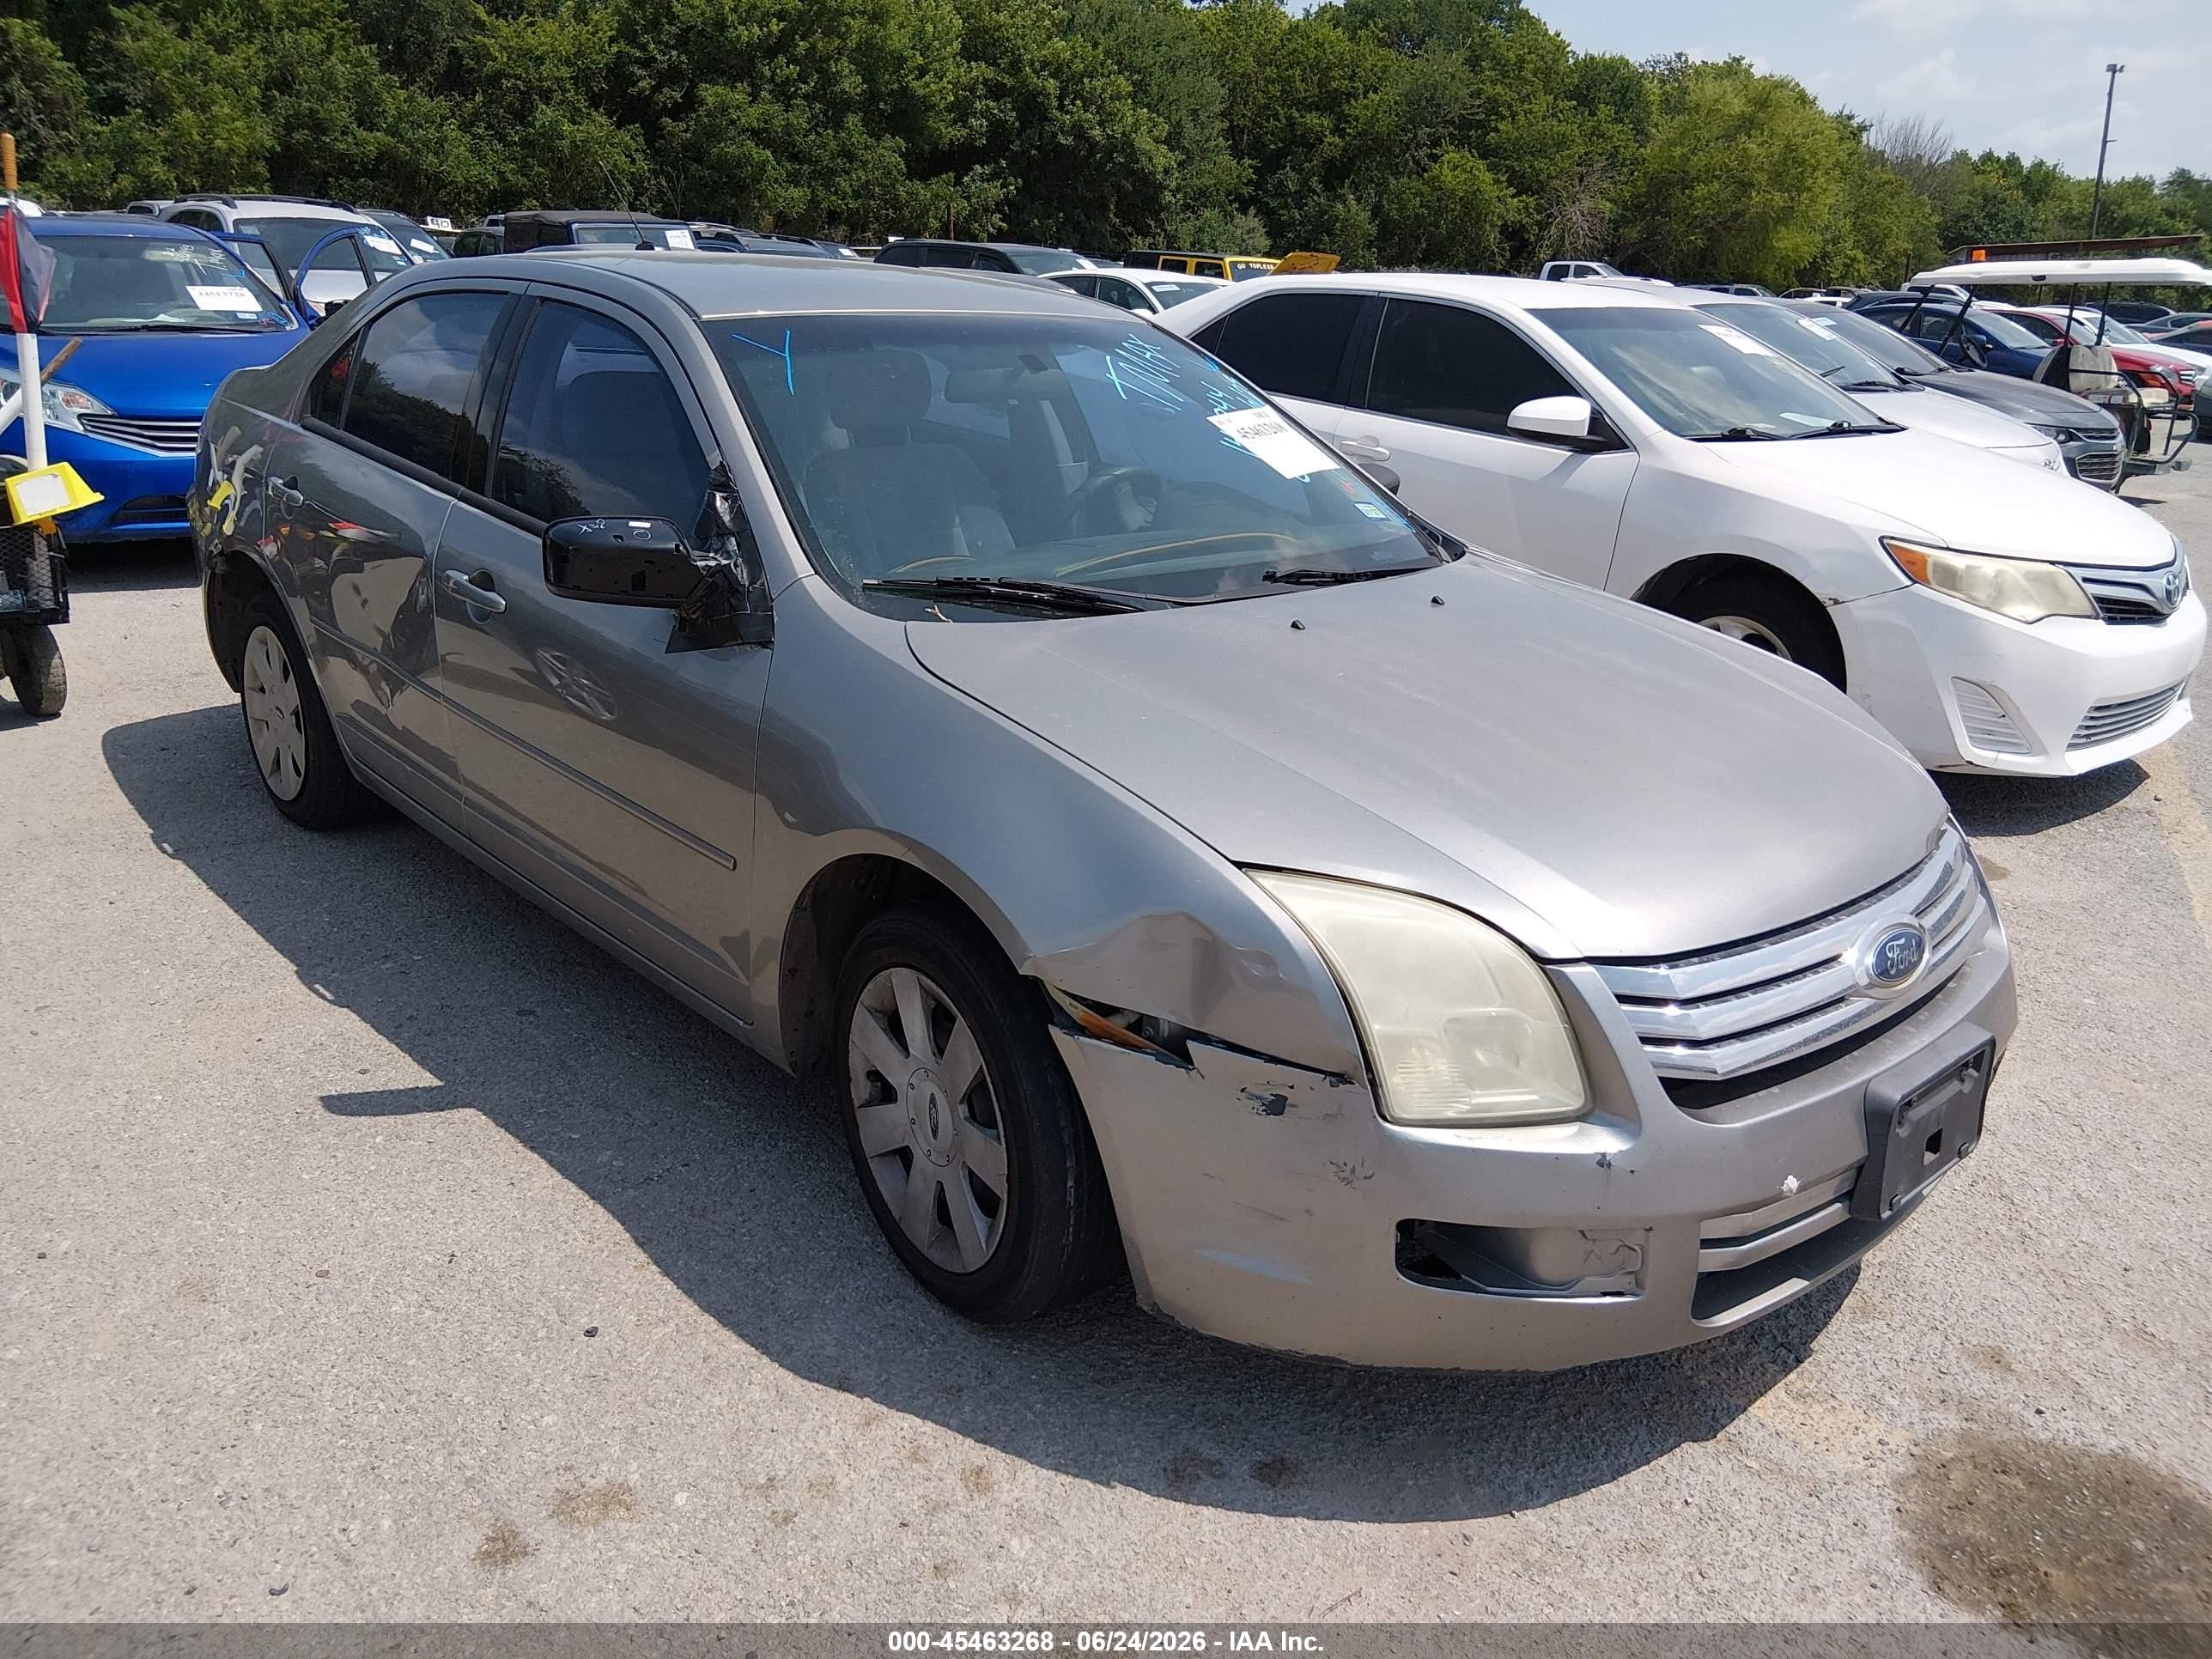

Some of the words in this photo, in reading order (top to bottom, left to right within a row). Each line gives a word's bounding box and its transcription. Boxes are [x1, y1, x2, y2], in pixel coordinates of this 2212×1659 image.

[1105, 332, 1185, 411] TMAX
[1237, 421, 1289, 440] 45463268
[1886, 937, 1918, 975] Ford
